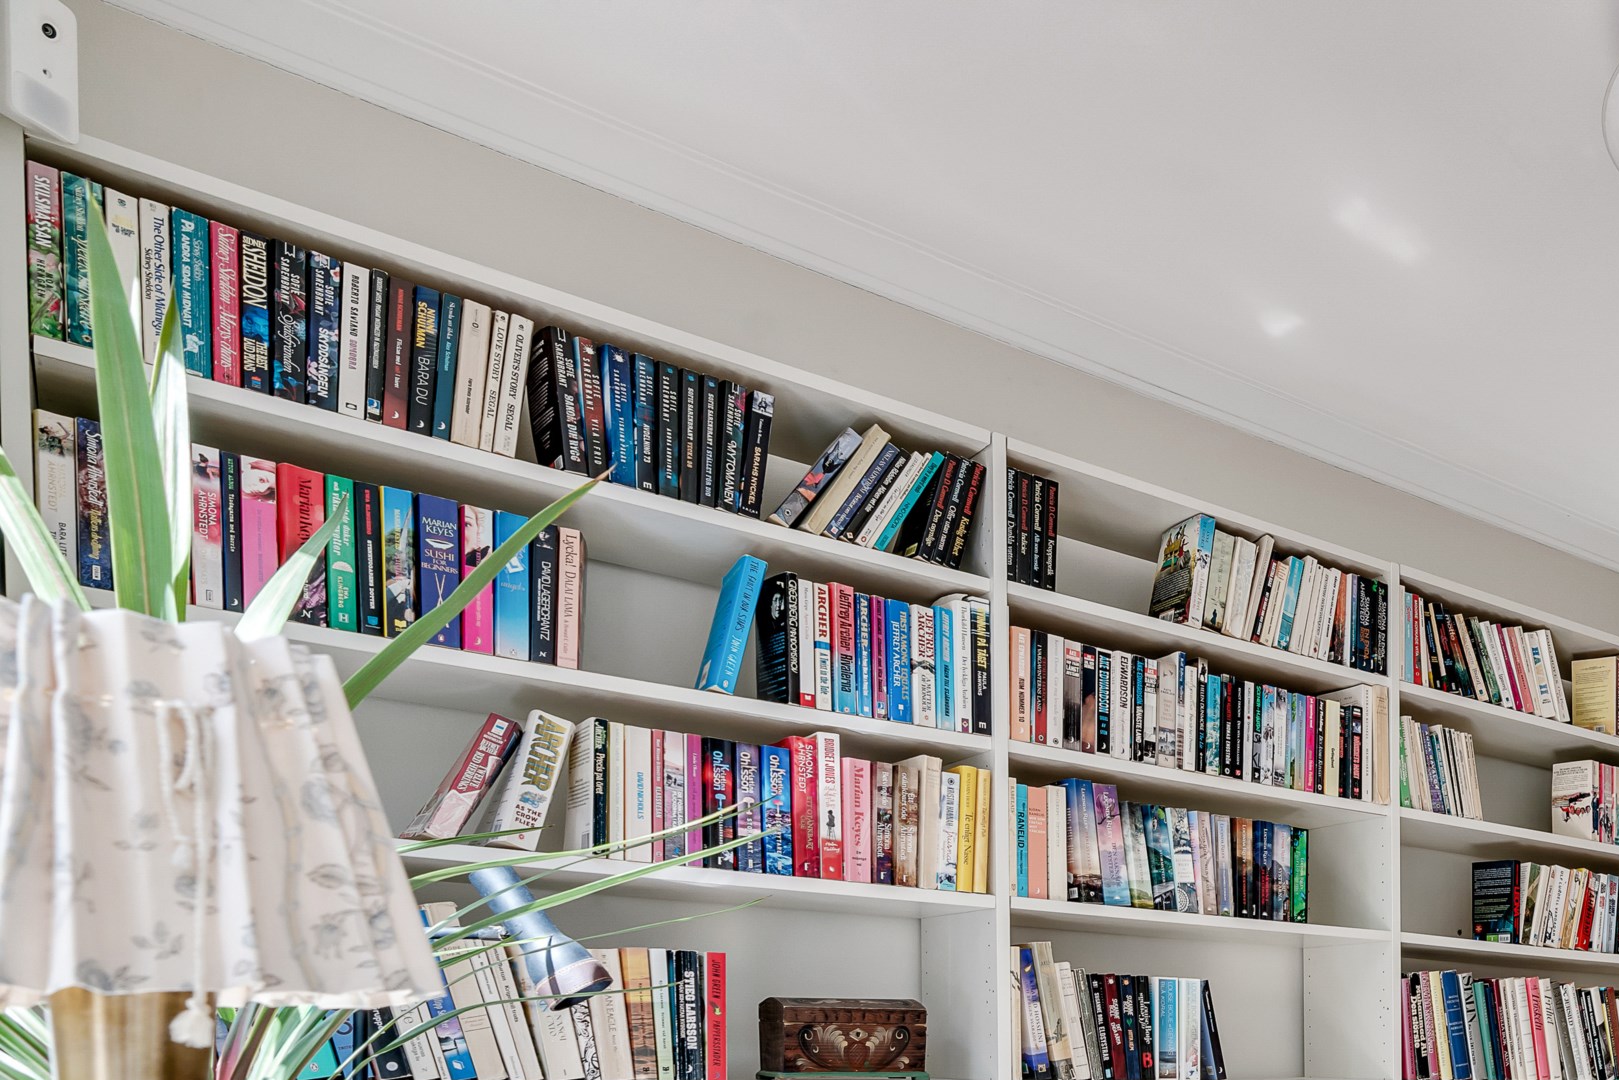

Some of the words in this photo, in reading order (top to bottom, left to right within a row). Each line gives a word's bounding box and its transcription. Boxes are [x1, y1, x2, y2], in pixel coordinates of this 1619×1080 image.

[34, 175, 54, 248] SKILSMÄSSAN
[153, 217, 165, 234] The
[154, 234, 165, 263] Other
[181, 234, 192, 262] ANDRA
[217, 229, 236, 263] Sidney
[243, 236, 266, 248] SIDNEY
[36, 258, 46, 298] HERNGREN
[45, 272, 53, 289] MOA
[153, 264, 165, 282] Side
[182, 264, 192, 289] SIDAN
[219, 263, 236, 302] Sheldon
[242, 245, 267, 309] SHELDON
[280, 256, 292, 305] SARENBRANT
[290, 274, 301, 295] SOFIE
[154, 284, 166, 296] of
[314, 268, 326, 315] SARENBRANT
[324, 285, 334, 305] SOFIE
[349, 274, 360, 304] ROBERTO
[182, 290, 192, 328] MIDNATT
[349, 307, 360, 337] SAVIANO
[426, 308, 436, 334] NINNI
[217, 307, 236, 341] Marys
[415, 302, 428, 348] SCHULMAN
[494, 327, 505, 349] LOVE
[219, 341, 235, 369] chans
[243, 337, 256, 354] LAID
[256, 341, 268, 355] THE
[277, 311, 301, 373] Själsfränden
[511, 334, 524, 372] OLIVER'S
[243, 353, 256, 372] PLANS
[256, 354, 268, 370] BEST
[317, 328, 330, 398] SKYDDSÄNGELN
[417, 356, 431, 385] BARA
[491, 350, 503, 381] STORY
[555, 342, 567, 387] SARENBRANT
[565, 357, 575, 377] SOFIE
[415, 387, 429, 405] DU
[508, 371, 520, 399] STORY
[486, 389, 498, 418] SEGAL
[504, 403, 516, 432] SEGAL
[725, 394, 735, 435] SARENBRANT
[733, 409, 742, 428] SOFIE
[84, 429, 102, 464] Simona
[567, 439, 581, 462] RYGG
[86, 466, 105, 508] Ahrnstedt
[724, 440, 738, 505] MYTOMANEN
[969, 463, 984, 487] Patricia
[197, 489, 208, 539] AHRNSTEDT
[207, 492, 217, 526] SIMONA
[963, 486, 978, 516] Cornwell
[421, 516, 457, 530] MARIAN
[424, 526, 454, 538] KEYES
[956, 516, 970, 536] Kuslig
[424, 549, 456, 562] SUSHI
[561, 534, 577, 568] Lycka!
[951, 536, 965, 557] likhet
[421, 562, 459, 575] BEGINNERS
[540, 561, 551, 585] DAVID
[748, 560, 760, 573] THE
[564, 571, 575, 594] DALAI
[744, 574, 757, 592] FAULT
[540, 585, 551, 641] LAGERCRANTZ
[564, 595, 574, 618] LAMA
[739, 600, 750, 612] OUR
[788, 579, 798, 626] GREENBERG
[817, 586, 828, 638] ARCHER
[838, 589, 854, 621] Jeffrey
[735, 612, 747, 632] STARS
[899, 611, 910, 631] FIRST
[731, 635, 745, 653] JOHN
[840, 620, 854, 652] Archer
[891, 621, 901, 652] JEFFREY
[899, 632, 909, 666] AMONG
[724, 654, 738, 677] GREEN
[840, 653, 854, 693] Rivalerna
[891, 651, 901, 687] ARCHER
[1099, 654, 1110, 669] ÅKE
[900, 667, 910, 700] EQUALS
[1099, 670, 1109, 714] EDWARDSON
[520, 714, 569, 792] ARCHER
[824, 737, 836, 762] BRIDGET
[825, 762, 835, 784] JONES
[853, 765, 865, 808] Marian
[514, 810, 537, 824] CROW
[851, 810, 865, 847] Keyes
[961, 823, 972, 843] enligt
[962, 844, 972, 865] Nasse
[684, 970, 695, 1001] STIEG
[1462, 975, 1476, 1023] STALIN
[686, 1003, 697, 1050] LARSSON
[1415, 984, 1426, 1040] Muhammad
[1412, 1016, 1421, 1049] störste
